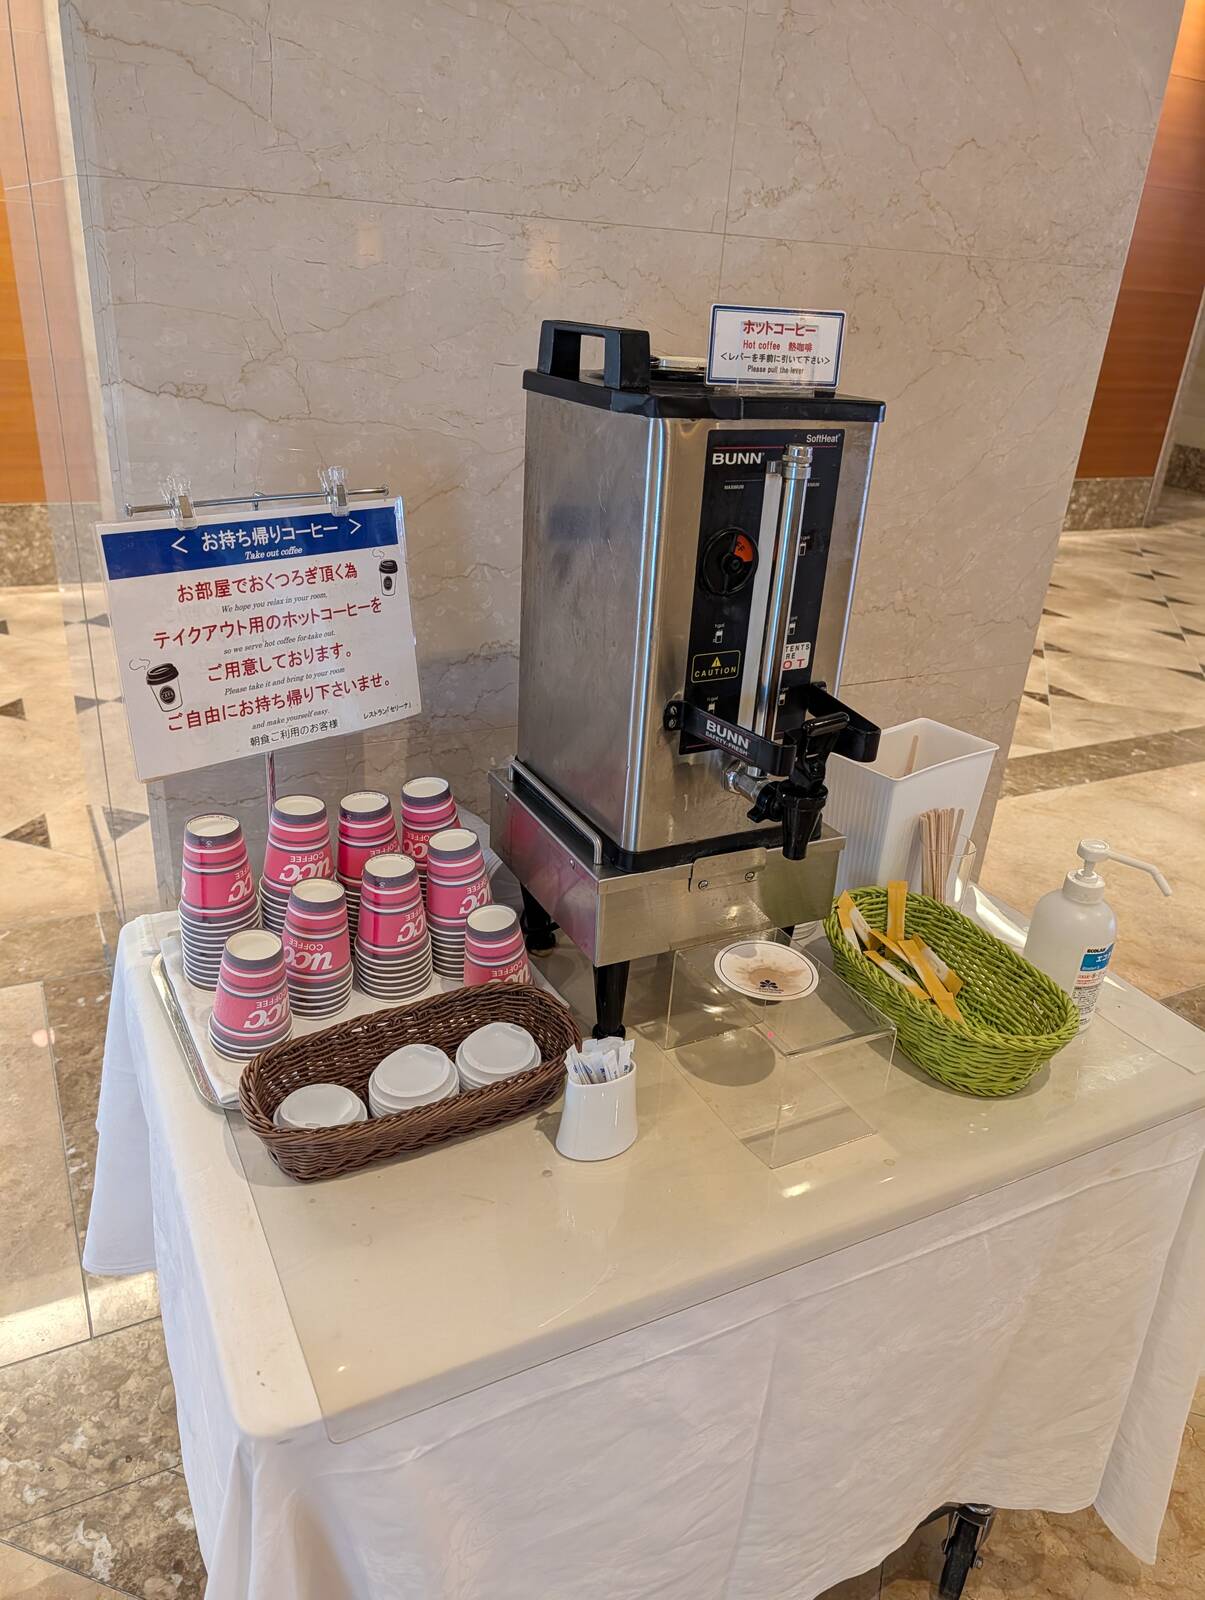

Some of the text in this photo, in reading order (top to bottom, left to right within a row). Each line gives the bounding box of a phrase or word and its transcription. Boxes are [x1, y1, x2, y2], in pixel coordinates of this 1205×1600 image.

[743, 320, 816, 336] ホットコーヒー
[743, 340, 756, 350] Hot
[758, 340, 780, 350] coffee
[747, 365, 766, 373] Please
[768, 366, 778, 374] pull
[790, 367, 804, 375] lever
[806, 434, 838, 444] SoftHeat
[712, 452, 762, 465] BUNN
[202, 522, 338, 552] お持ち帰りコーヒー
[244, 546, 303, 560] Take out coffee
[177, 562, 358, 603] お部屋でおくつろぎ頂く為
[222, 605, 233, 613] We
[234, 602, 250, 613] hope
[252, 601, 265, 609] you
[266, 596, 284, 606] relax
[293, 594, 309, 604] your
[153, 597, 382, 649] テイクアウト用のホットコーヒーを
[264, 639, 275, 648] hot
[276, 636, 296, 646] coffee
[785, 644, 810, 652] TENTS
[208, 642, 352, 682] ご用意しております。
[783, 659, 805, 670] OT
[694, 666, 736, 678] CAUTION
[224, 685, 248, 696] Please
[249, 683, 263, 691] take
[272, 678, 285, 687] and
[287, 674, 304, 686] bring
[313, 670, 328, 680] your
[168, 673, 390, 731] ご自由にお持ち帰り下さいませ。
[252, 708, 330, 730] and make yourself easy.
[250, 719, 338, 746] 朝食ご利用のお客様
[706, 720, 750, 750] BUNN
[406, 832, 430, 842] OFFEE
[290, 850, 324, 863] COFFEE
[403, 840, 428, 858] CC
[397, 914, 424, 942] CC
[288, 938, 323, 951] COFFEE
[491, 960, 523, 978] COFFEE
[256, 991, 286, 1009] COFFEE
